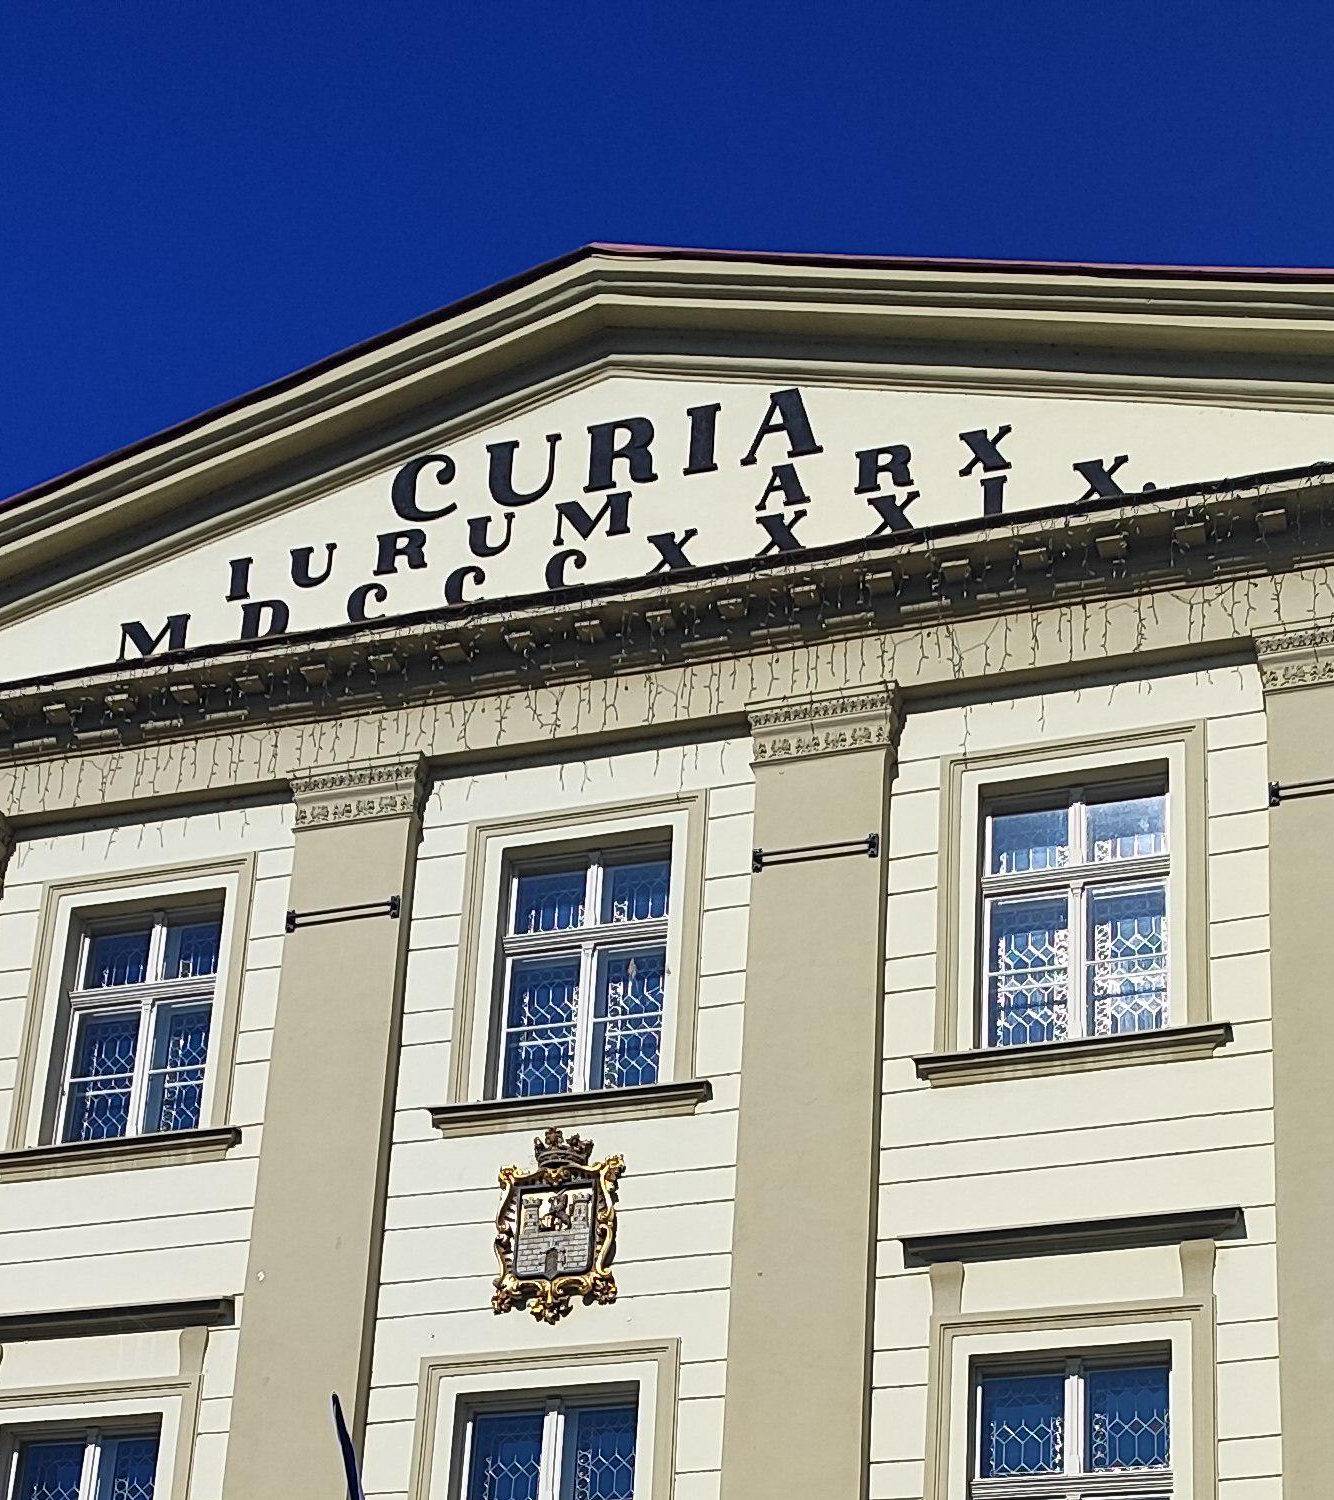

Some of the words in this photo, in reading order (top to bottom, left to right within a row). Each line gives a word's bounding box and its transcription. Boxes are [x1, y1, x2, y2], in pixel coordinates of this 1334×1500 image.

[225, 490, 632, 602] IURUM
[755, 424, 1013, 511] ARX
[391, 387, 824, 522] CURIA
